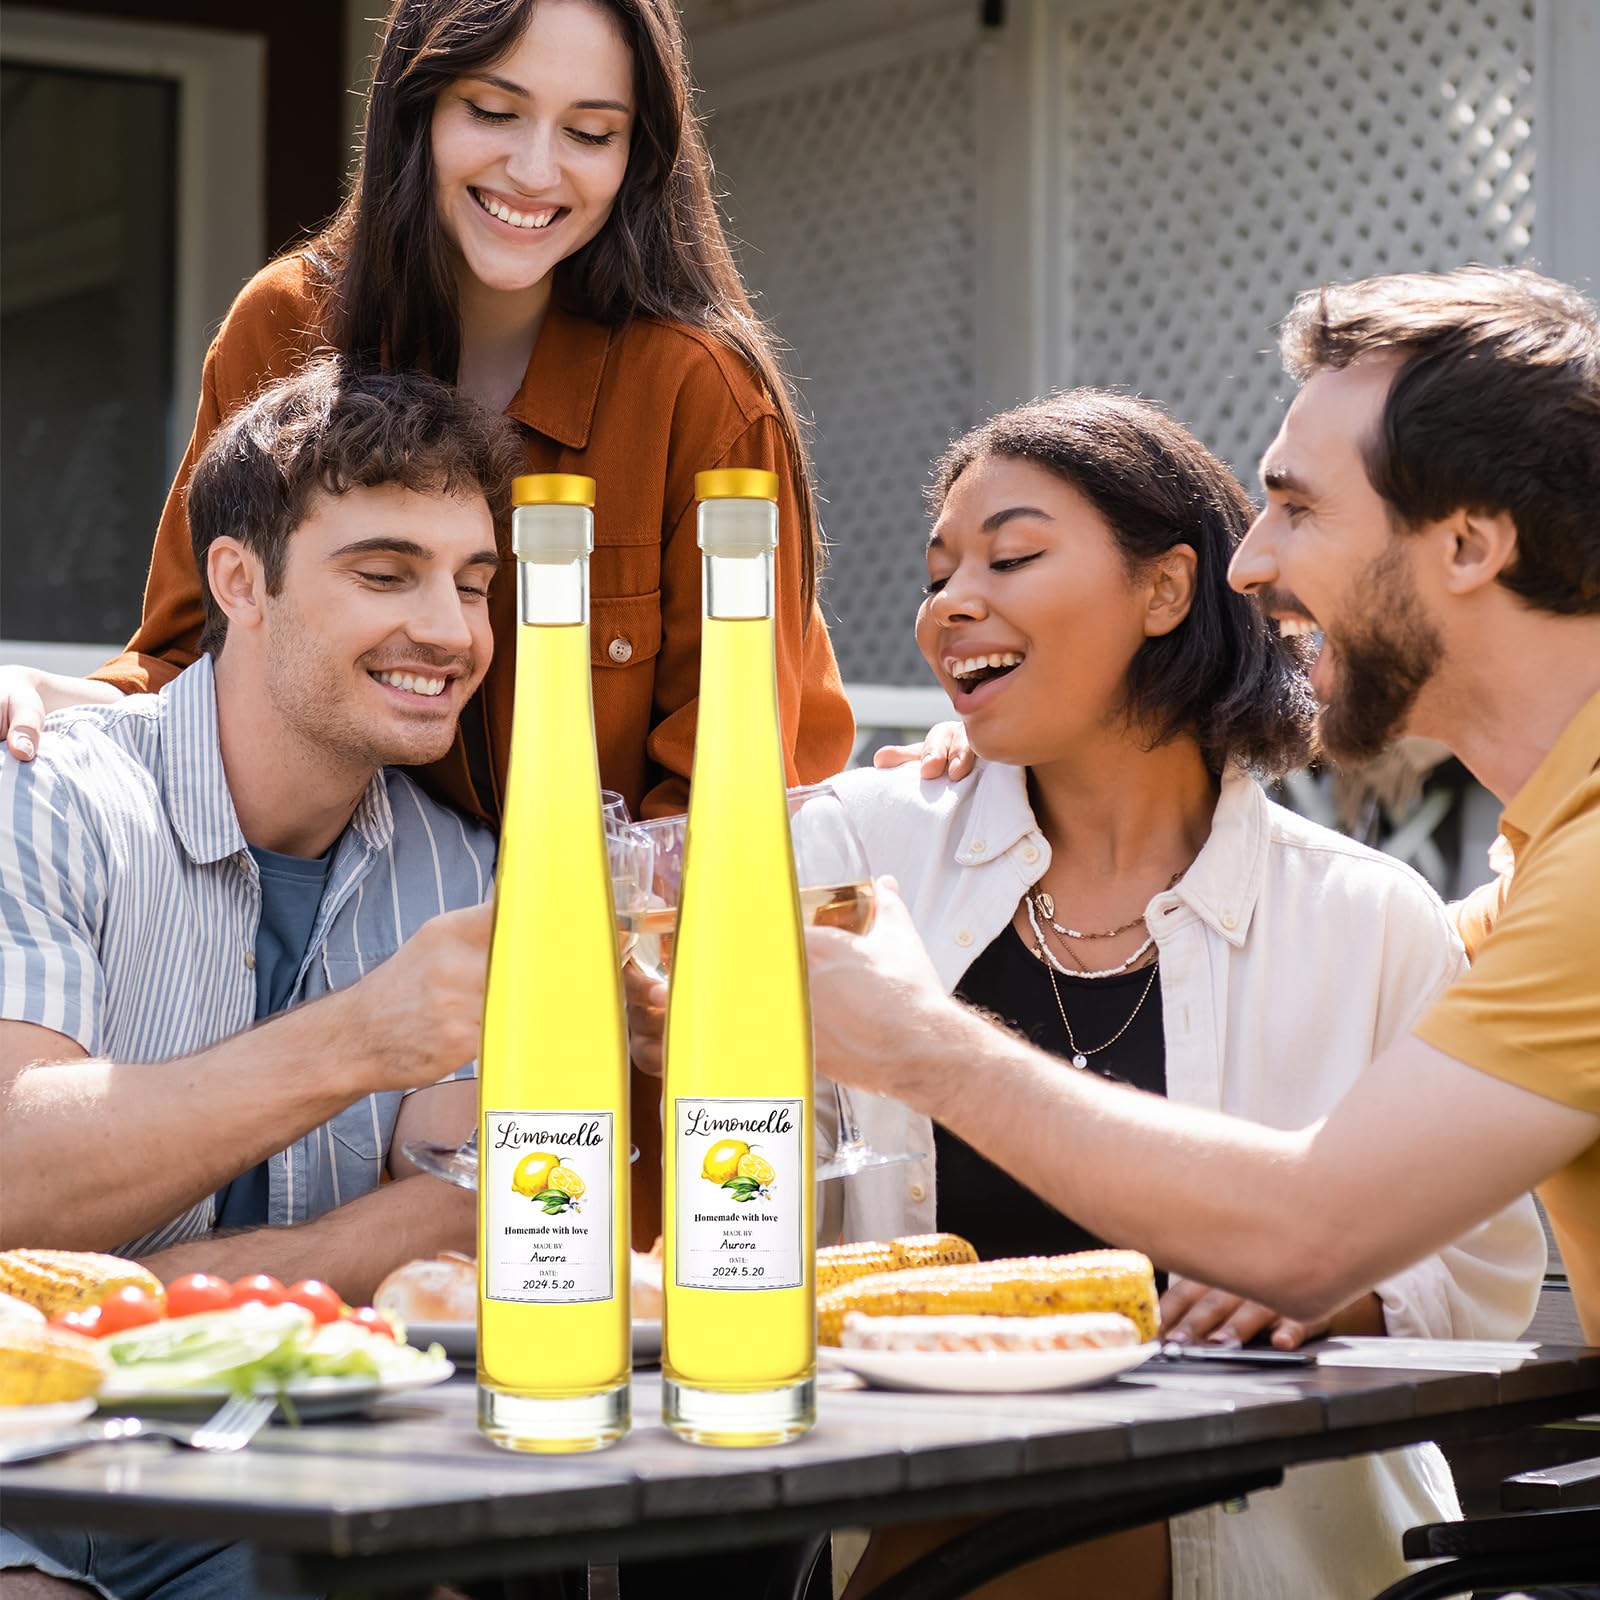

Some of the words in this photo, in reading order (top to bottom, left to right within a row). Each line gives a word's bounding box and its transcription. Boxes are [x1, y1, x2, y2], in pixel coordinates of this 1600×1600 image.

[685, 1108, 793, 1136] Limoncello
[495, 1121, 603, 1149] Limoncello
[694, 1213, 740, 1222] Homemade
[742, 1213, 760, 1222] with
[762, 1213, 778, 1222] love
[505, 1226, 550, 1235] Homemade
[552, 1226, 570, 1235] with
[572, 1226, 588, 1235] love
[720, 1239, 756, 1250] Aurora
[530, 1252, 566, 1263] Aurora
[712, 1266, 765, 1277] 2024.5.20
[522, 1279, 575, 1289] 2024.5.20
